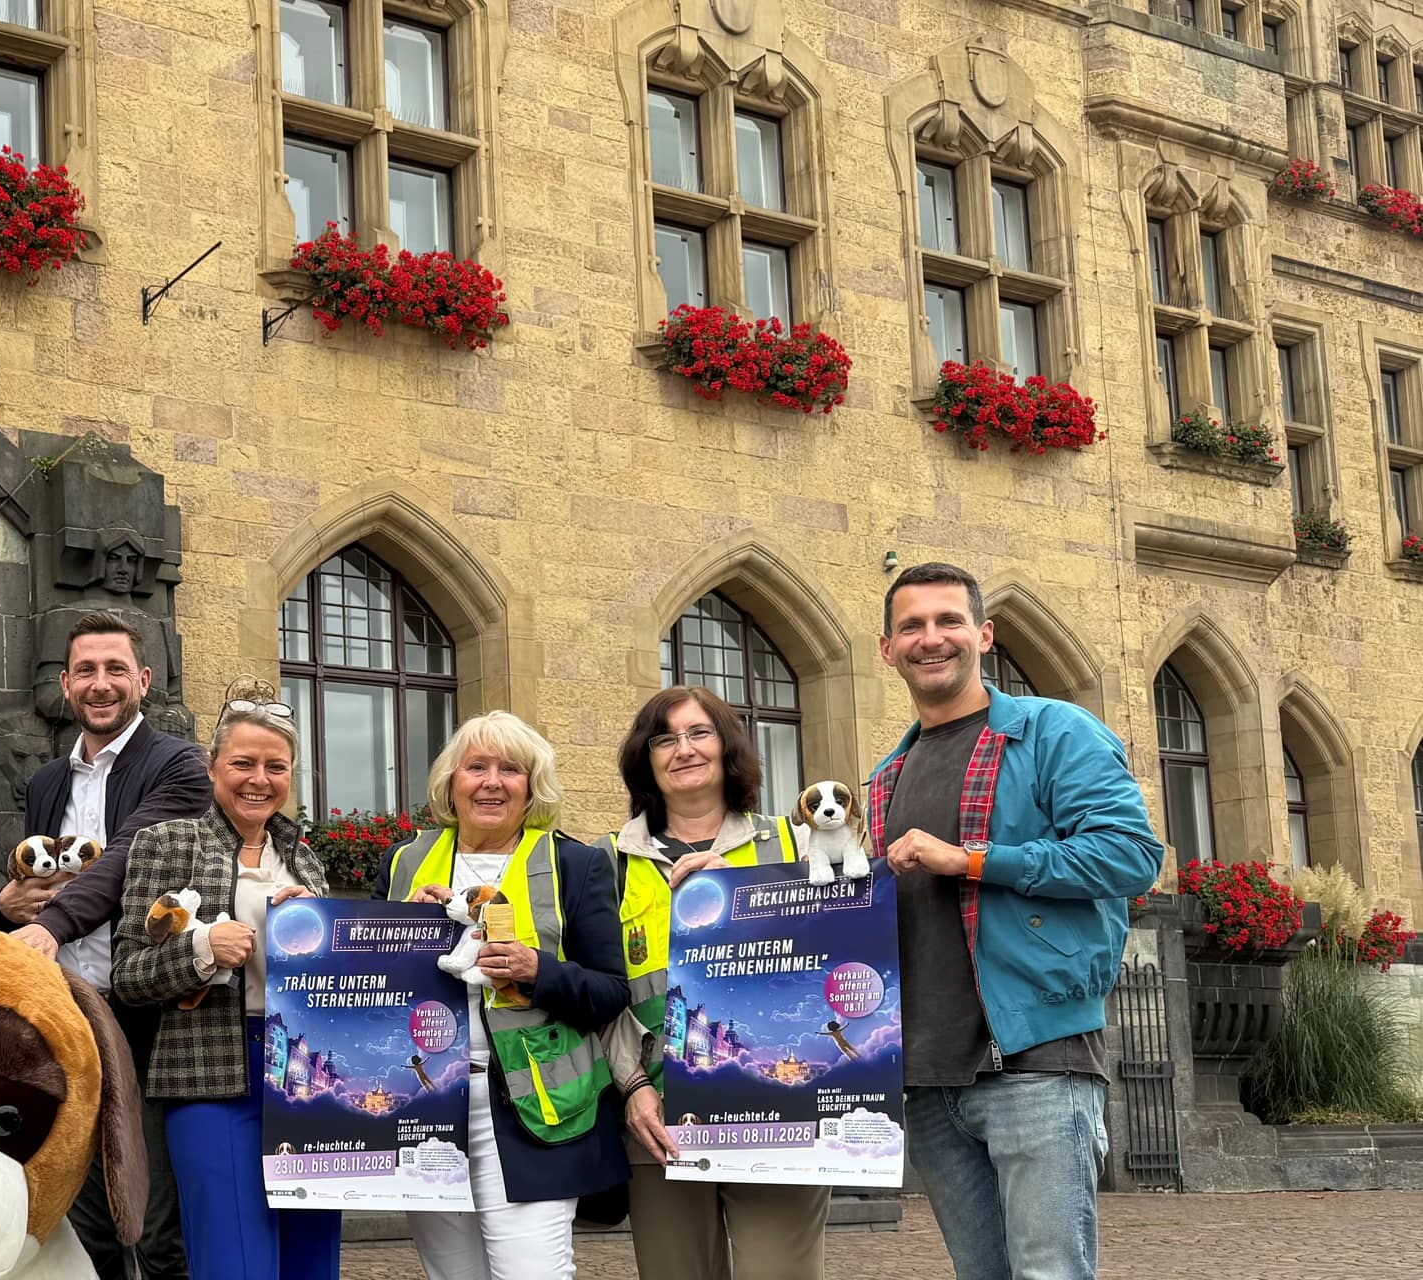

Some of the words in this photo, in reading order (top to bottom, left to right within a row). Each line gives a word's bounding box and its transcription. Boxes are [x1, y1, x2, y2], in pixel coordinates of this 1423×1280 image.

[749, 883, 856, 907] RECKLINGHAUSEN
[349, 926, 441, 941] RECKLINGHAUSEN
[738, 938, 794, 958] UNTERM
[832, 969, 874, 981] Verkaufs-
[339, 974, 387, 991] UNTERM
[839, 980, 872, 991] offener
[829, 992, 865, 1002] Sonntag
[867, 991, 880, 1000] am
[416, 1007, 450, 1017] Verkaufs-
[421, 1017, 447, 1027] offener
[412, 1028, 442, 1038] Sonntag
[443, 1029, 454, 1037] am
[817, 1095, 833, 1103] LASS
[835, 1095, 860, 1103] DEINEN
[862, 1093, 885, 1102] TRAUM
[817, 1103, 851, 1112] LEUCHTEN
[709, 1110, 781, 1123] re-leuchtet.de
[397, 1125, 411, 1133] LASS
[412, 1125, 434, 1133] DEINEN
[435, 1124, 454, 1132] TRAUM
[397, 1133, 426, 1141] LEUCHTEN
[678, 1129, 714, 1145] 23.10.
[718, 1128, 738, 1144] bis
[743, 1126, 811, 1143] 08.11.2026
[303, 1139, 366, 1152] re-leuchtet.de
[274, 1159, 308, 1175] 23.10.
[311, 1157, 329, 1173] bis
[333, 1155, 392, 1172] 08.11.2026
